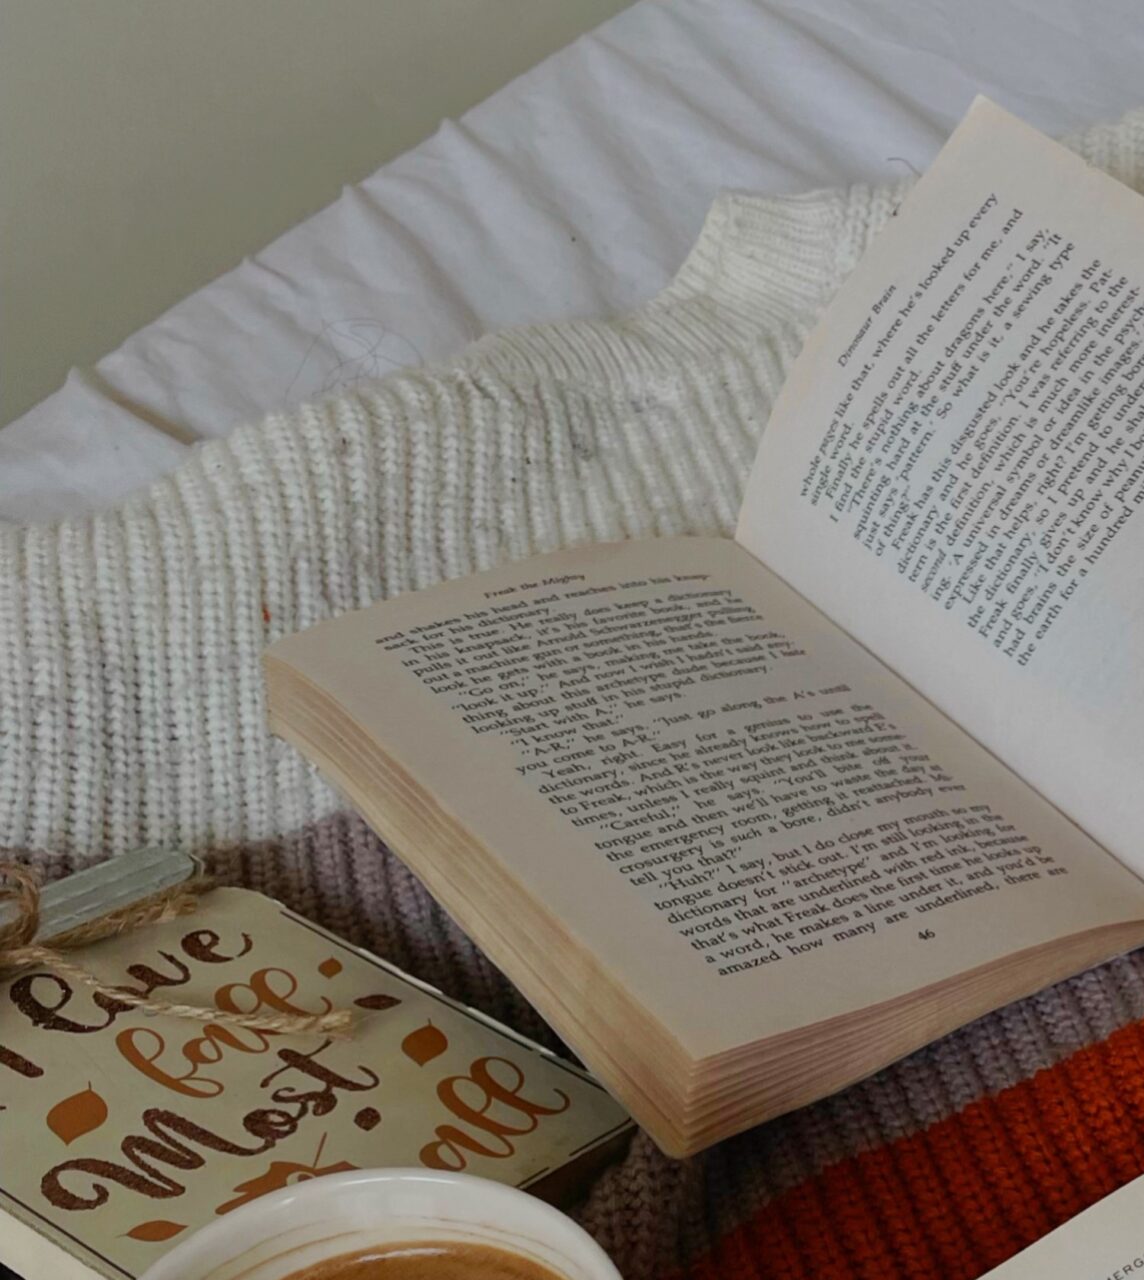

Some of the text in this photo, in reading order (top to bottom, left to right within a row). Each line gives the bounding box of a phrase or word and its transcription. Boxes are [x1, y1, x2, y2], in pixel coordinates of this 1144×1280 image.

[799, 455, 822, 497] whole
[833, 392, 854, 419] like
[850, 362, 876, 392] that,
[871, 318, 903, 358] where
[917, 246, 957, 291] looked
[953, 229, 971, 247] up
[968, 192, 999, 229] every
[809, 422, 855, 507] single word.
[1083, 505, 1135, 566] hundred
[1002, 627, 1027, 659] had
[1022, 581, 1058, 625] brains
[1055, 554, 1077, 578] the
[1076, 523, 1100, 551] size
[1099, 501, 1115, 520] of
[1059, 578, 1080, 602] for
[1078, 567, 1089, 578] a
[1016, 642, 1037, 667] the
[1034, 604, 1063, 640] earth
[678, 835, 1030, 938] words that are underlined with red ink, because
[717, 866, 1069, 977] amazed how many are underlined, there are
[740, 916, 784, 936] what
[781, 902, 832, 924] Freak
[831, 892, 869, 909] does
[868, 882, 897, 896] the
[896, 871, 929, 888] first
[928, 861, 963, 877] time
[960, 856, 984, 867] he
[981, 847, 1023, 862] looks
[1021, 845, 1043, 856] up
[918, 928, 936, 941] 46
